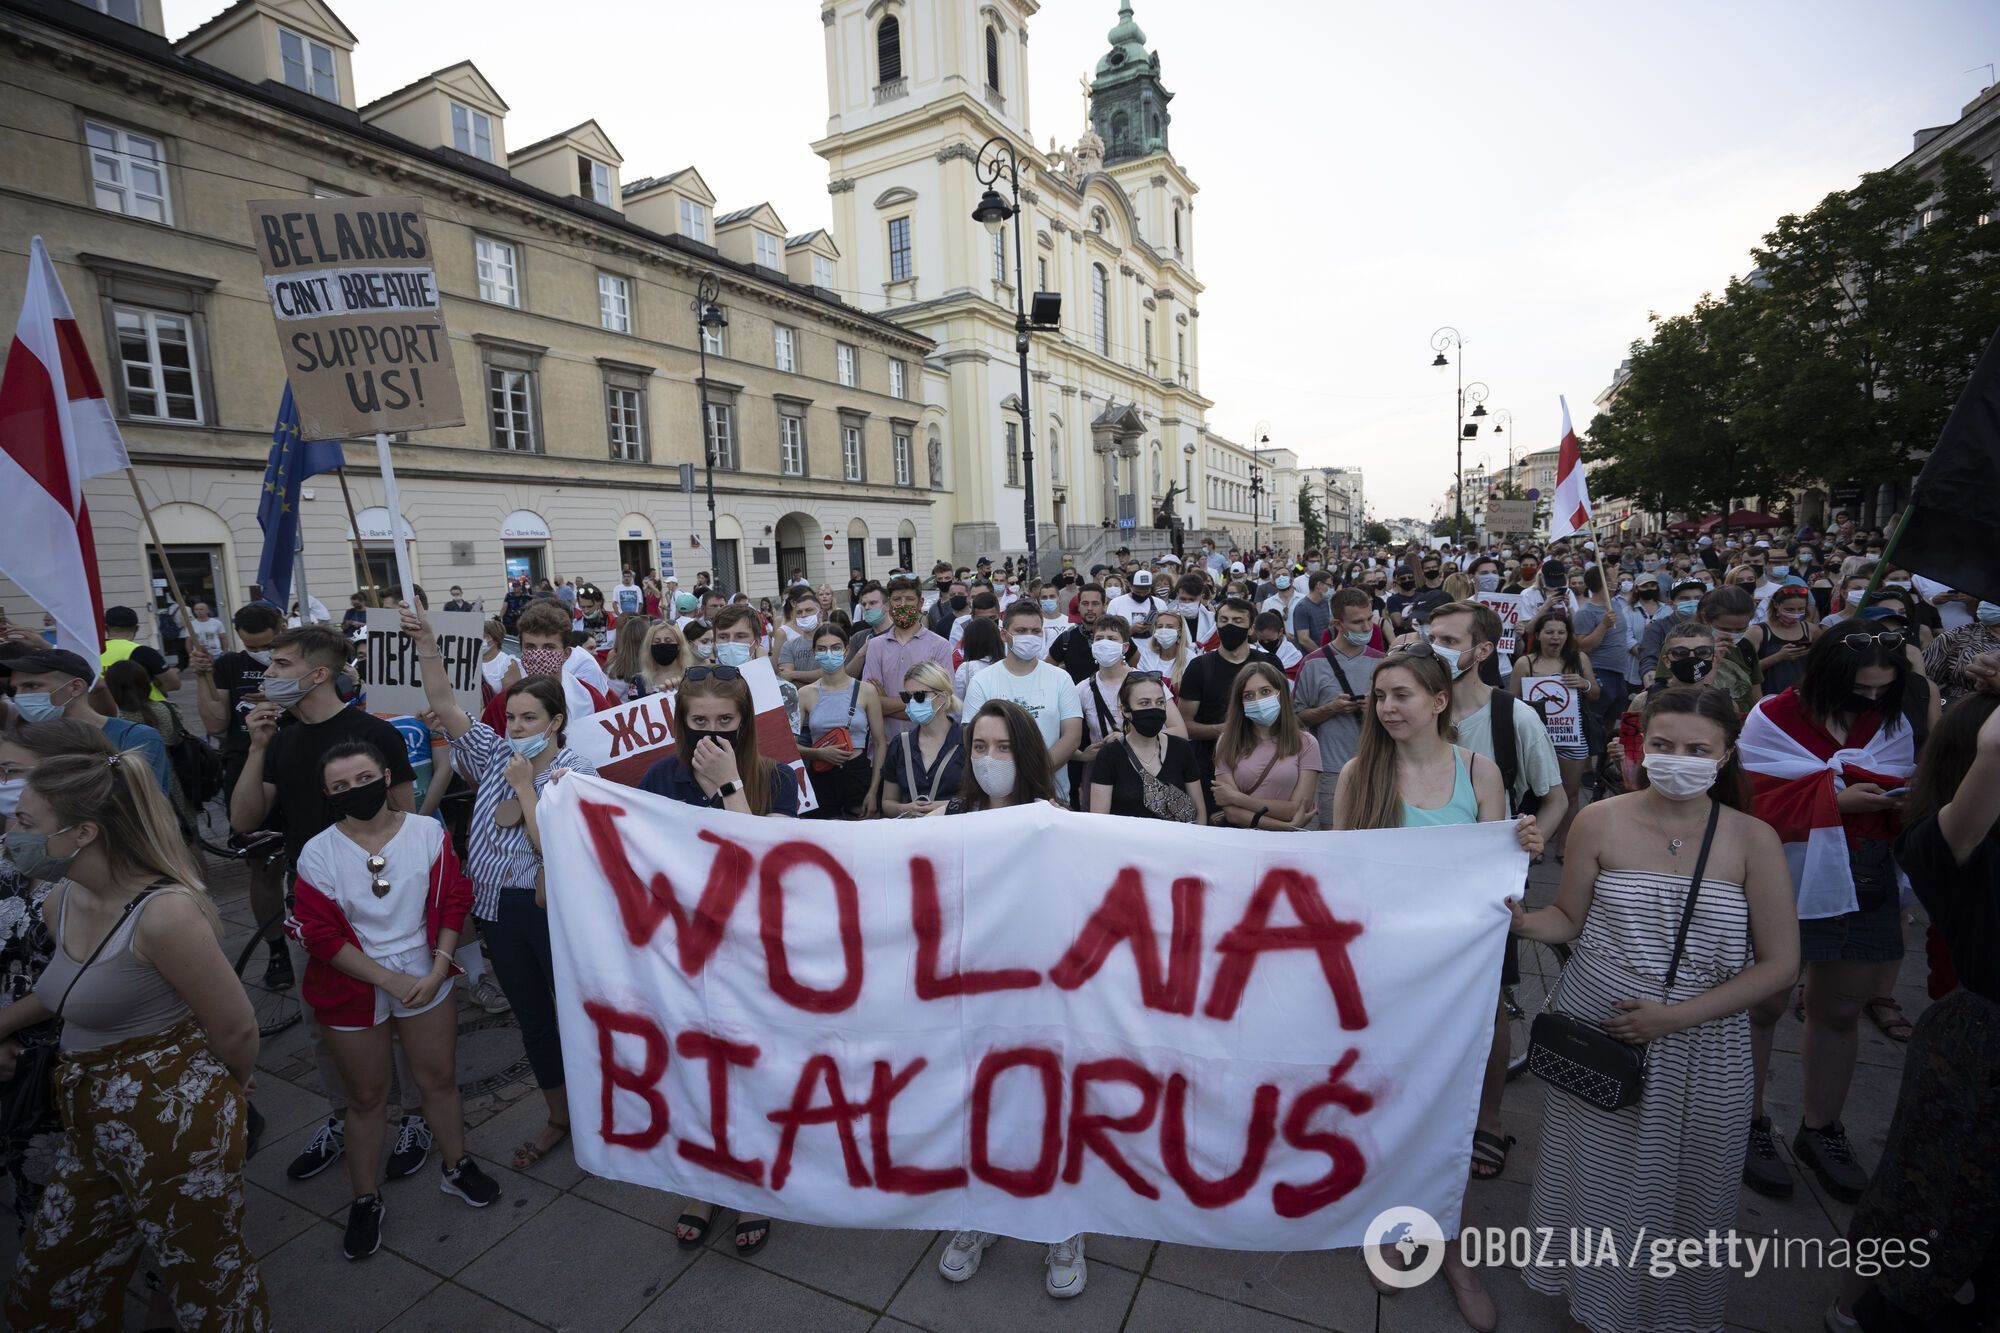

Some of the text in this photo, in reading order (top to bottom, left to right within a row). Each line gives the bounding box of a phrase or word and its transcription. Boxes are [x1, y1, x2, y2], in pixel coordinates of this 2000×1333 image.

[261, 212, 426, 267] BELARUS
[275, 273, 436, 316] CAN'T BREATHE
[291, 324, 440, 372] SUPPORT
[345, 368, 425, 413] US!
[1119, 520, 1135, 528] TAXI
[1503, 628, 1515, 638] NT
[599, 697, 676, 758] ЖЫ
[1545, 716, 1575, 726] TARCZY
[1555, 735, 1579, 743] ZMIAN
[579, 799, 1369, 1031] WOLNA
[584, 1000, 1374, 1218] BIAŁORUŚ
